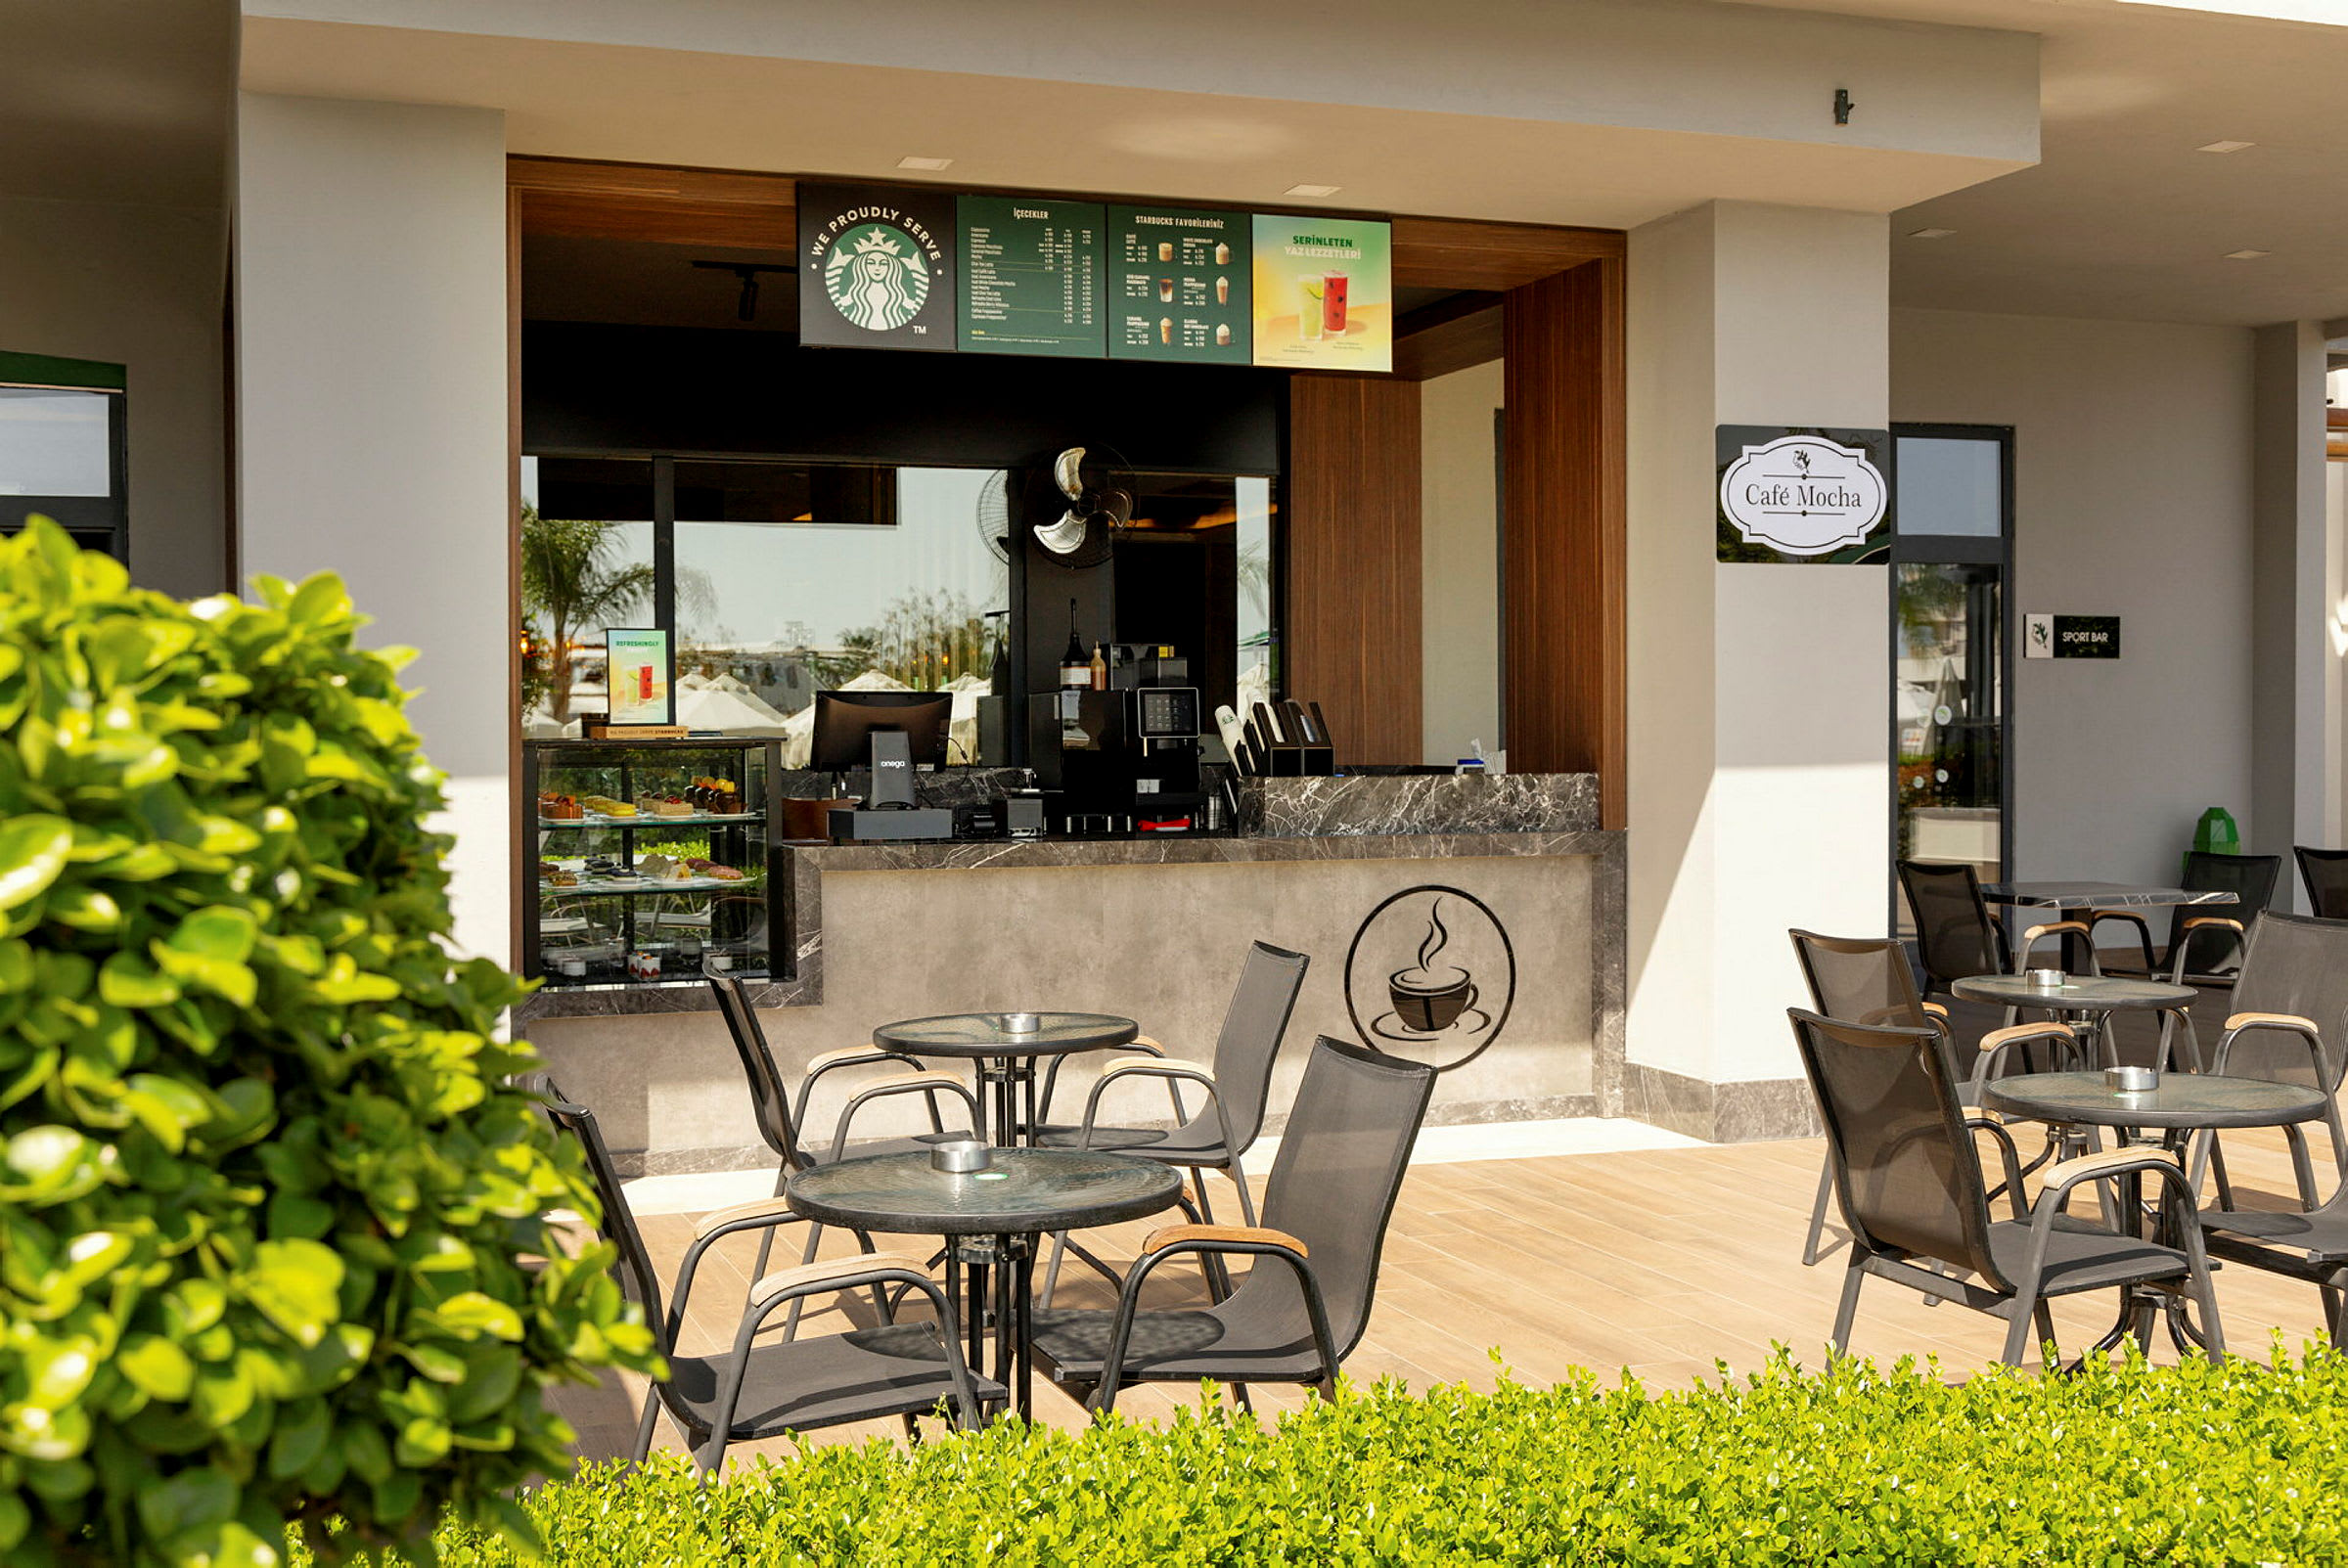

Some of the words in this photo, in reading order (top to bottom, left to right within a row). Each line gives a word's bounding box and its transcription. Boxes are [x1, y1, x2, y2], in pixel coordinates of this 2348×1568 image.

[1014, 207, 1049, 219] İÇECEKLER
[1135, 215, 1174, 226] STARBUCKS
[811, 233, 831, 256] WE
[829, 206, 900, 233] PROUDLY
[903, 217, 942, 261] SERVE
[1292, 235, 1353, 247] SERİNLETEN
[1285, 246, 1306, 256] YAZ
[1306, 246, 1362, 259] LEZZETLERİ
[913, 326, 927, 335] TM
[1745, 483, 1790, 506] Café
[1796, 485, 1862, 508] Mocha
[2061, 631, 2090, 643] SPORT
[2091, 632, 2109, 643] BAR
